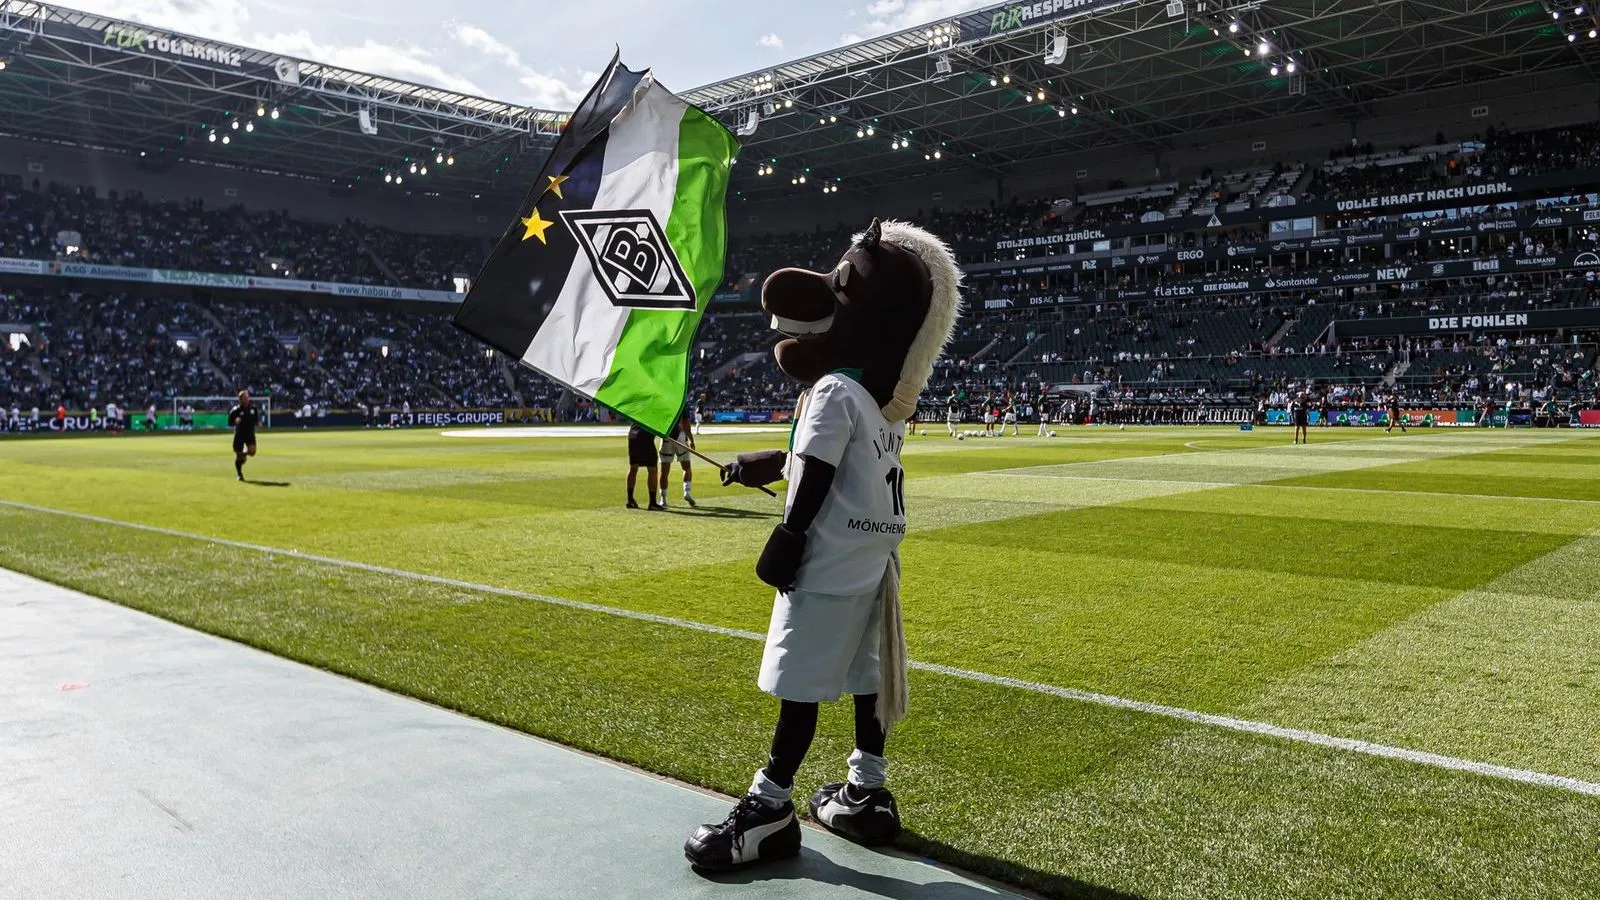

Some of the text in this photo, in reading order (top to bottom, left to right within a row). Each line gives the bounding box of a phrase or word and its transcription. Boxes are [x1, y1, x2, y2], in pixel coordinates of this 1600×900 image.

[1022, 0, 1093, 21] RESPE
[147, 35, 242, 67] TOLERANZ
[1336, 182, 1512, 211] VOLLE KRAFT NACH VORN.
[996, 229, 1105, 250] STOLZER BLICK ZURÜCK.
[1177, 250, 1204, 261] ERGO
[64, 265, 86, 274] ASG
[90, 267, 147, 279] Aluminium
[1377, 267, 1408, 280] NEW
[1203, 281, 1249, 292] DIE FOHLEN
[1276, 277, 1319, 287] Santander
[338, 285, 402, 298] www.habau.de
[984, 299, 1007, 309] PUMA
[1030, 297, 1043, 305] DIS
[1043, 296, 1053, 304] AG
[1428, 313, 1528, 330] DIE FOHLEN
[417, 412, 504, 424] FEIES-GRUPPE
